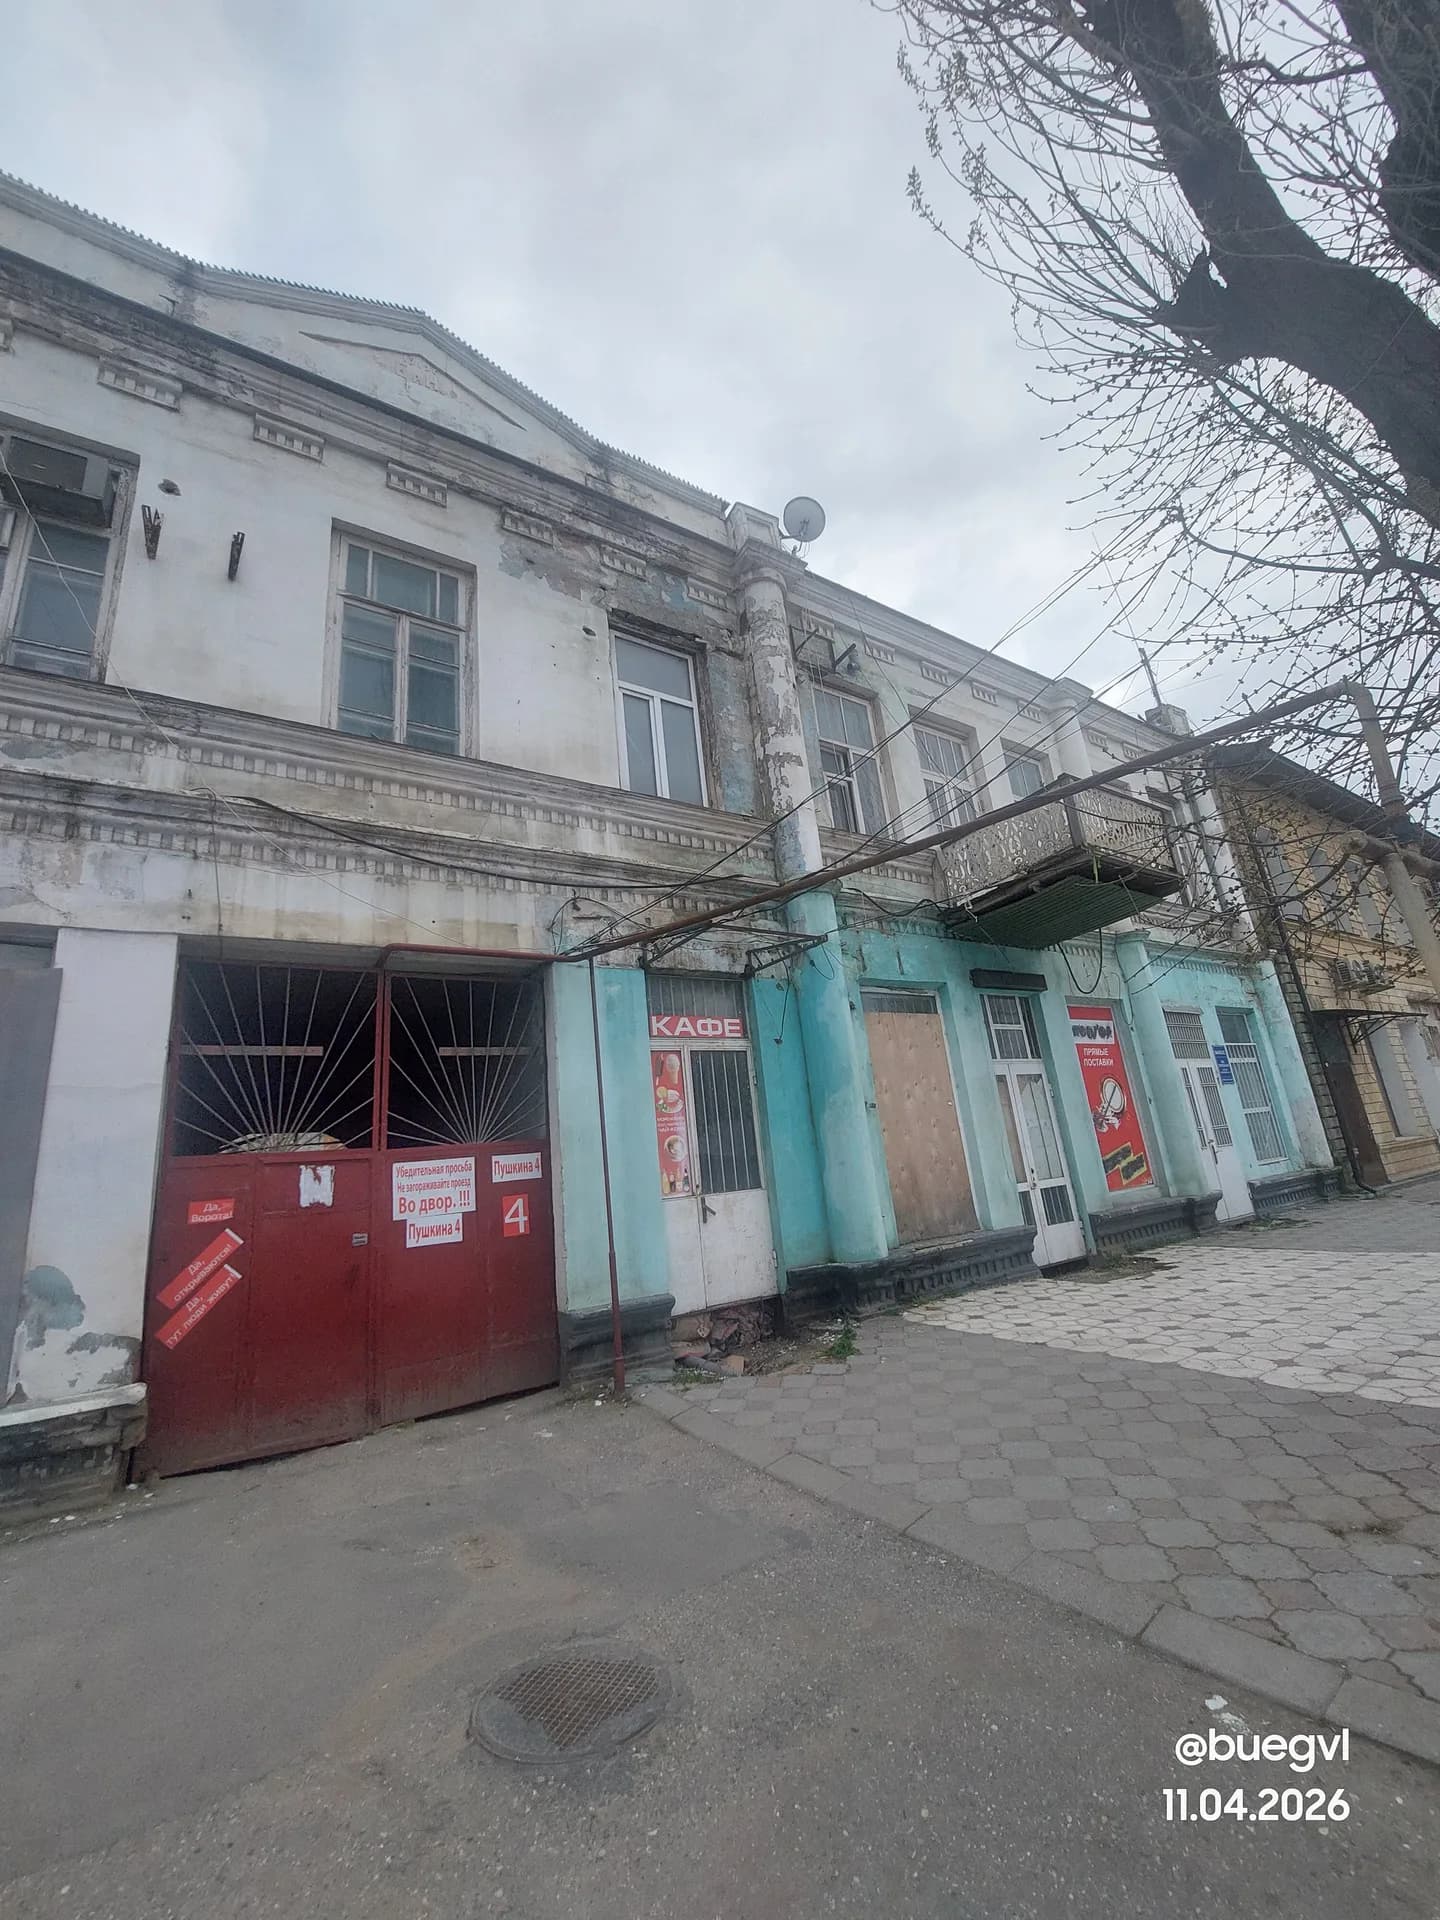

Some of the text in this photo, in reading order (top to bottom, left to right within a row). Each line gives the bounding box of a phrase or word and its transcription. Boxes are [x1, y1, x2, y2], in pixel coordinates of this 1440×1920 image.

[651, 1016, 742, 1038] КАФЕ
[1083, 1047, 1109, 1056] ПРЯМЫЕ
[1083, 1058, 1114, 1067] ПОСТАВКИ
[396, 1161, 472, 1179] Убедительная просьба
[494, 1159, 540, 1178] Пушкина 4
[397, 1178, 471, 1193] Не загораживайте проезд
[399, 1197, 416, 1214] Во
[504, 1198, 528, 1233] 4
[409, 1219, 461, 1243] Пушкина 4
[184, 1304, 207, 1328] люди
